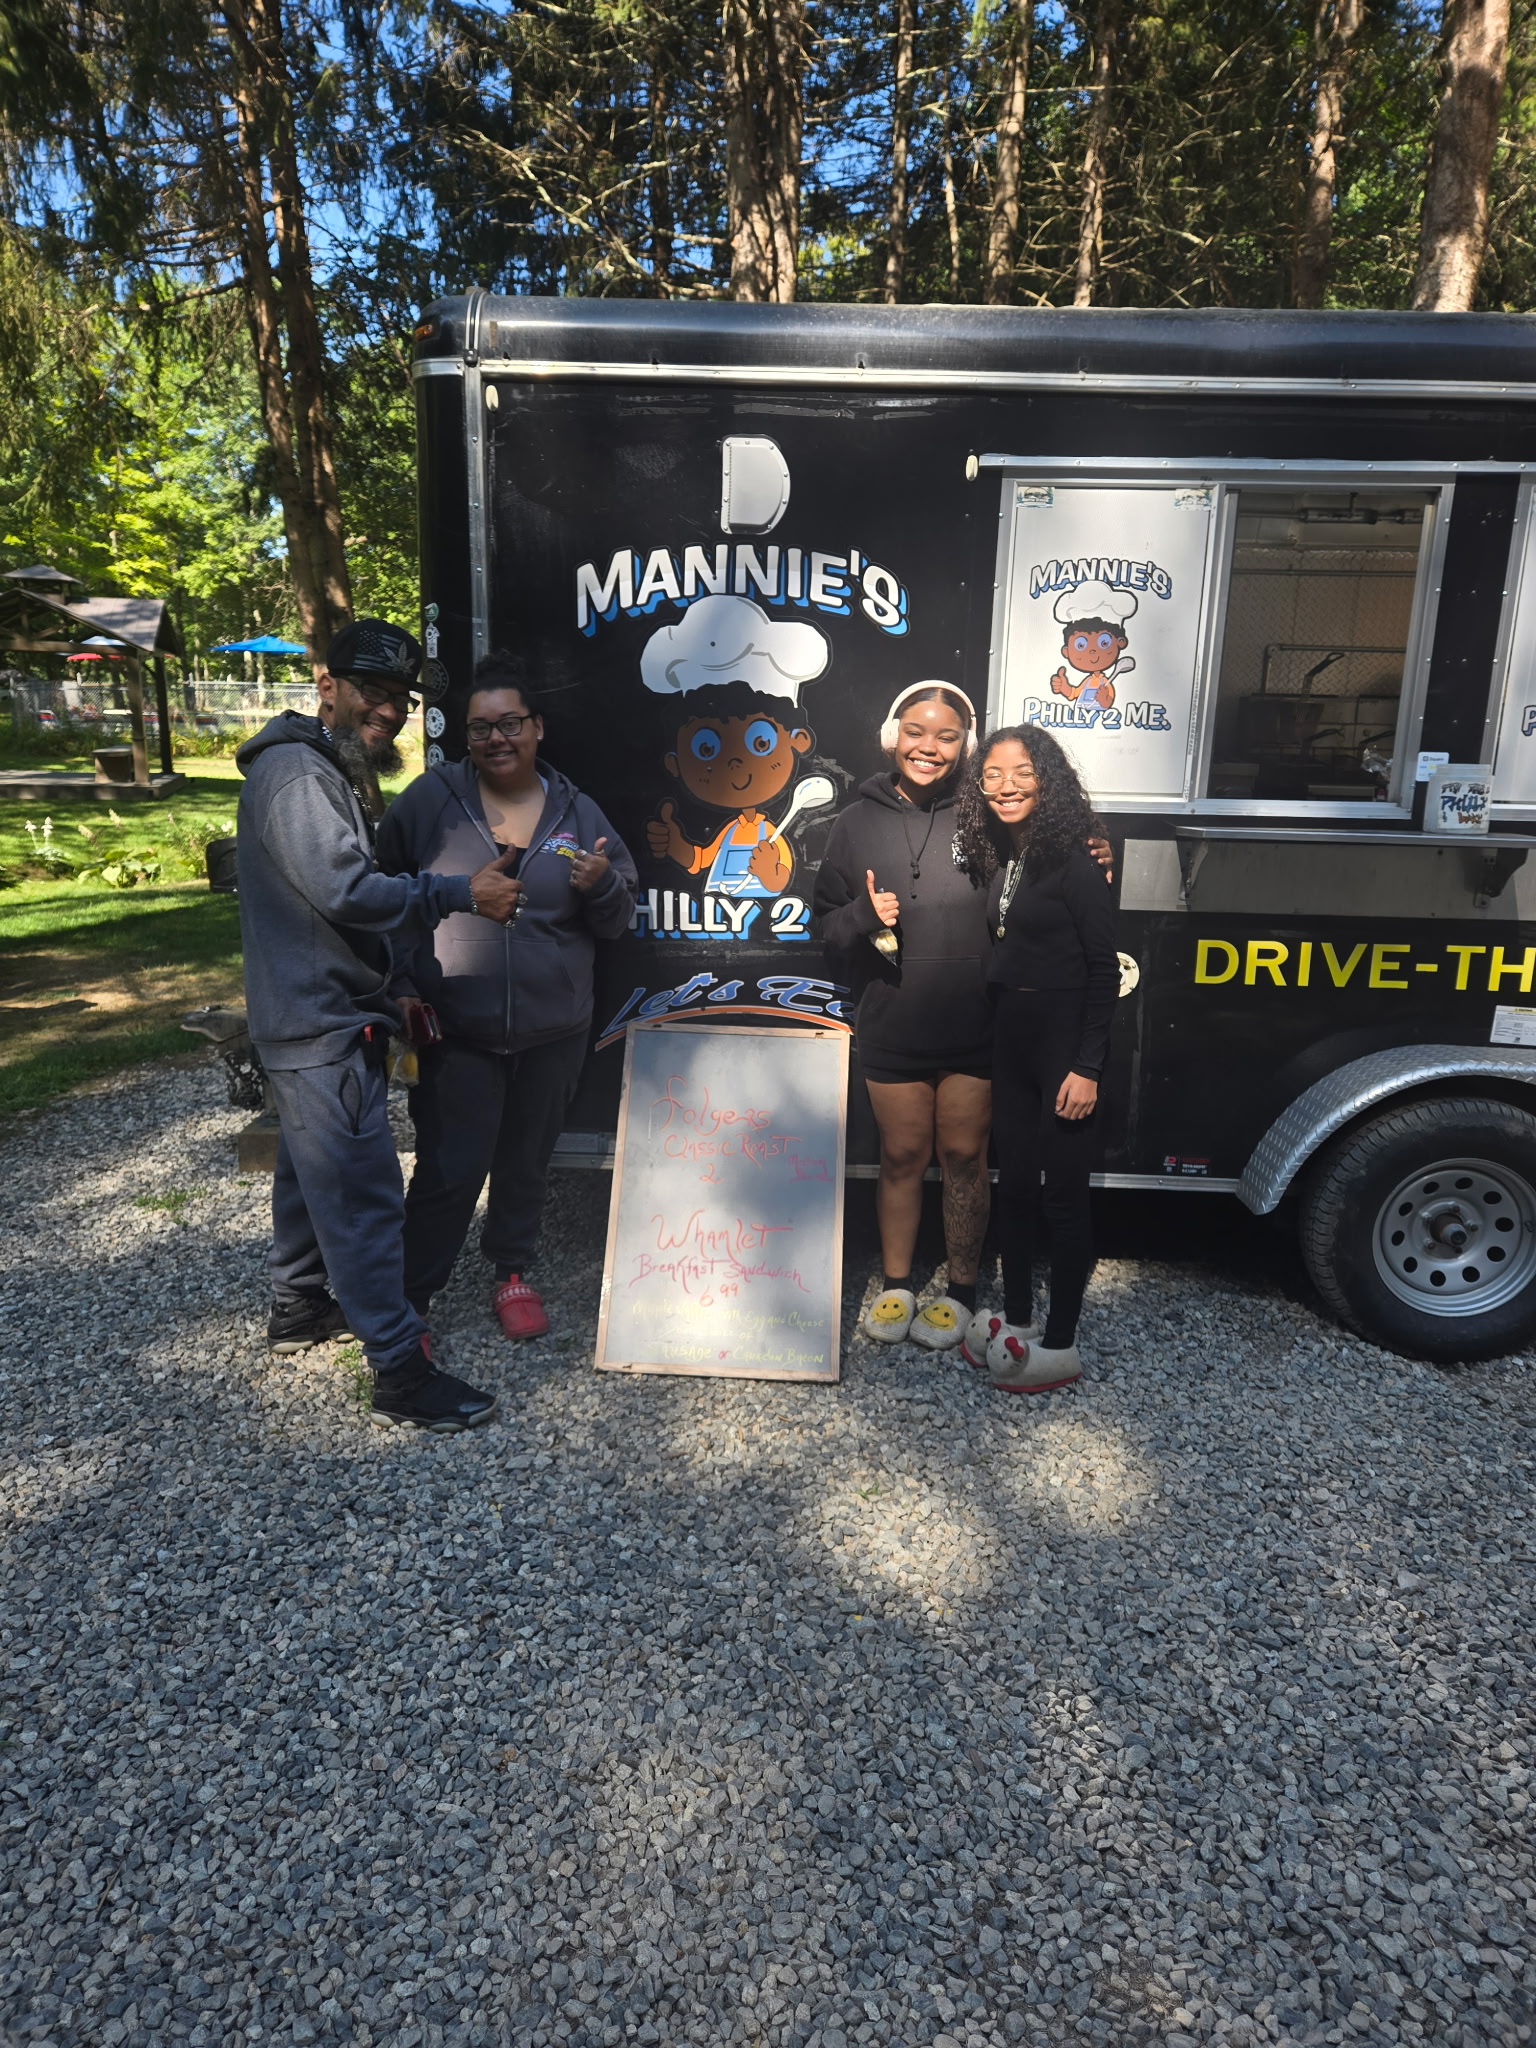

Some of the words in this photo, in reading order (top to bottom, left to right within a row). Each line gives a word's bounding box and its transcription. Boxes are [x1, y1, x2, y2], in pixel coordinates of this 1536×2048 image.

[576, 544, 909, 637] MANNIE'S
[1029, 558, 1172, 599] MANNIE'S
[1023, 697, 1099, 728] PHILLY
[1101, 707, 1121, 729] 2
[1125, 702, 1171, 731] ME.
[628, 888, 763, 940] HILLY
[770, 896, 811, 941] 2
[1194, 939, 1536, 993] DRIVE-TH
[601, 972, 744, 1038] Let's
[757, 975, 858, 1019] Ea
[699, 1162, 725, 1184] 2
